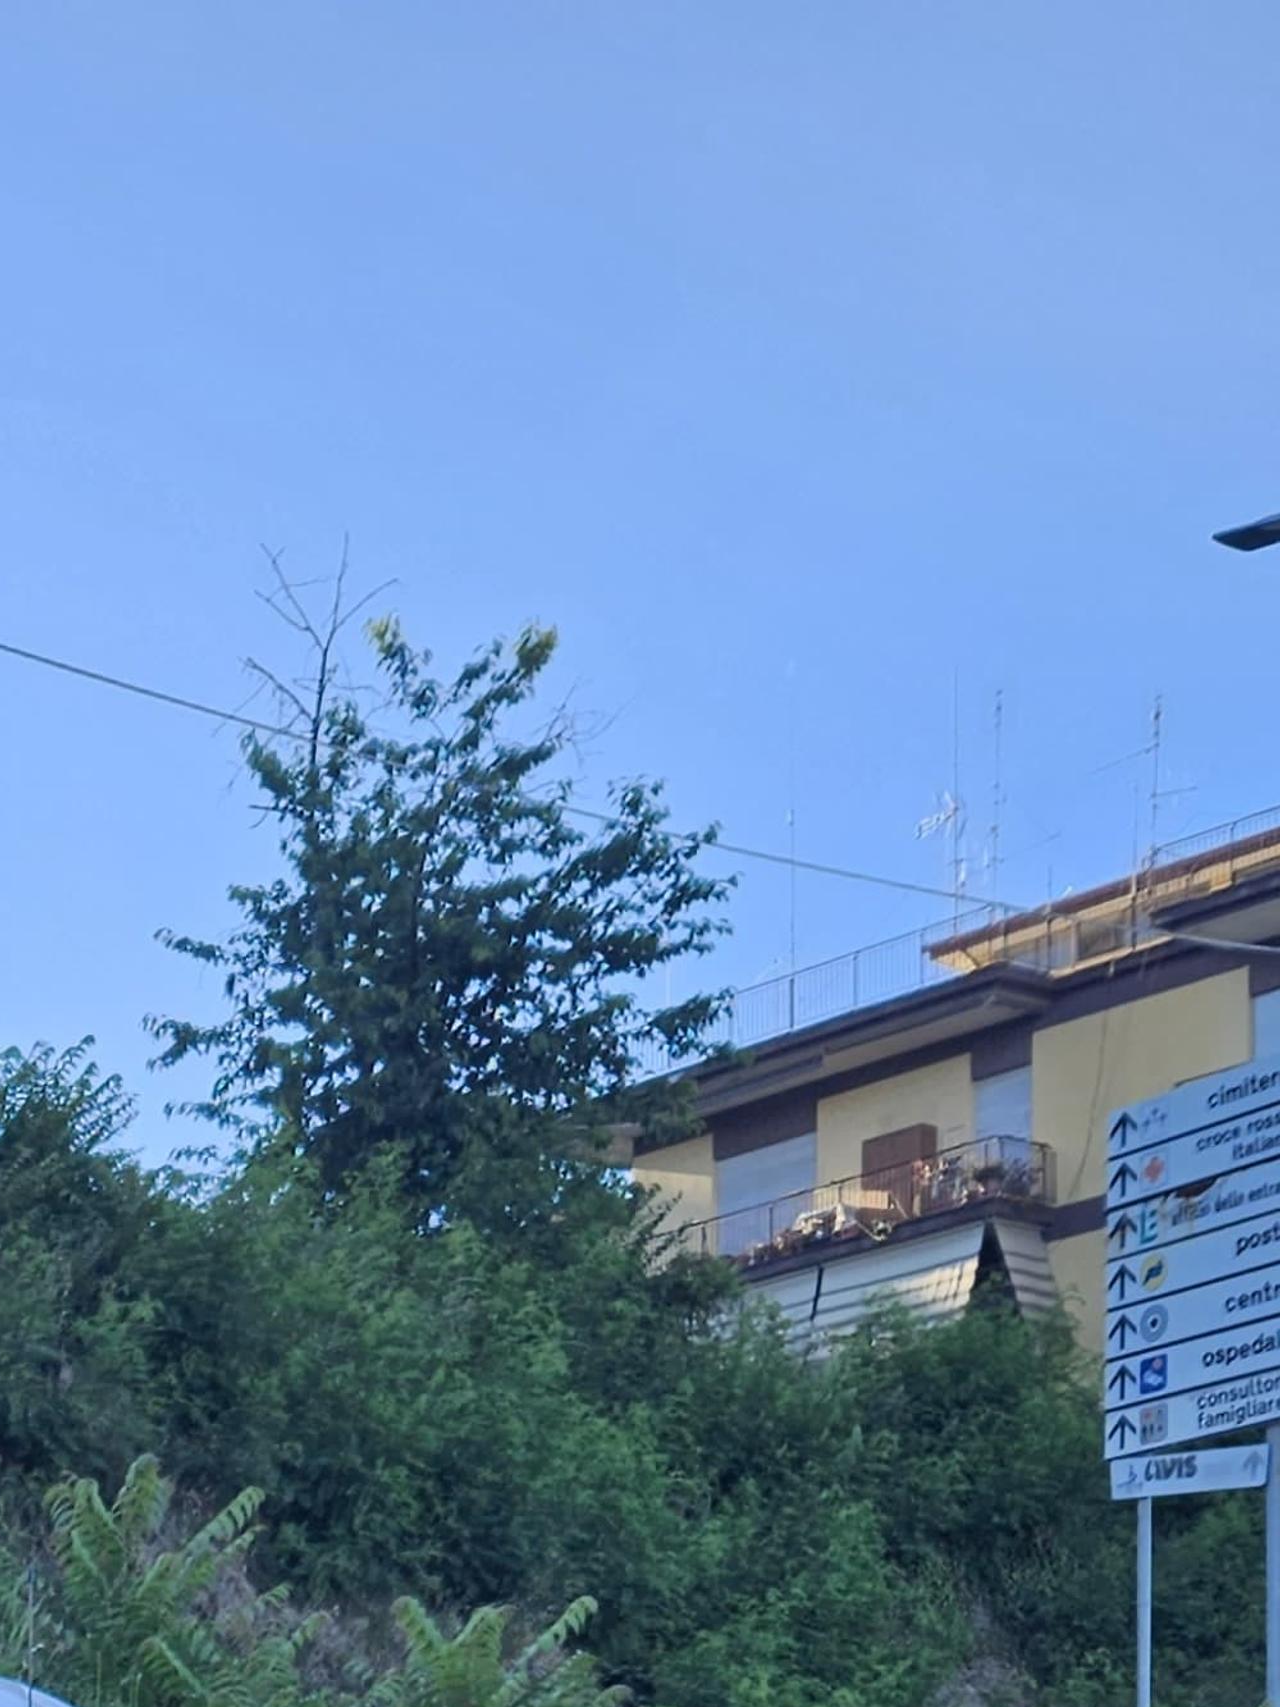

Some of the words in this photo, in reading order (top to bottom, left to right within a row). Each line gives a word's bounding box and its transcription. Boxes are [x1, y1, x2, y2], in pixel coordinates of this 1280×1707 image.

[1196, 1127, 1241, 1152] croce
[1236, 1221, 1280, 1257] post
[1225, 1281, 1280, 1312] centr
